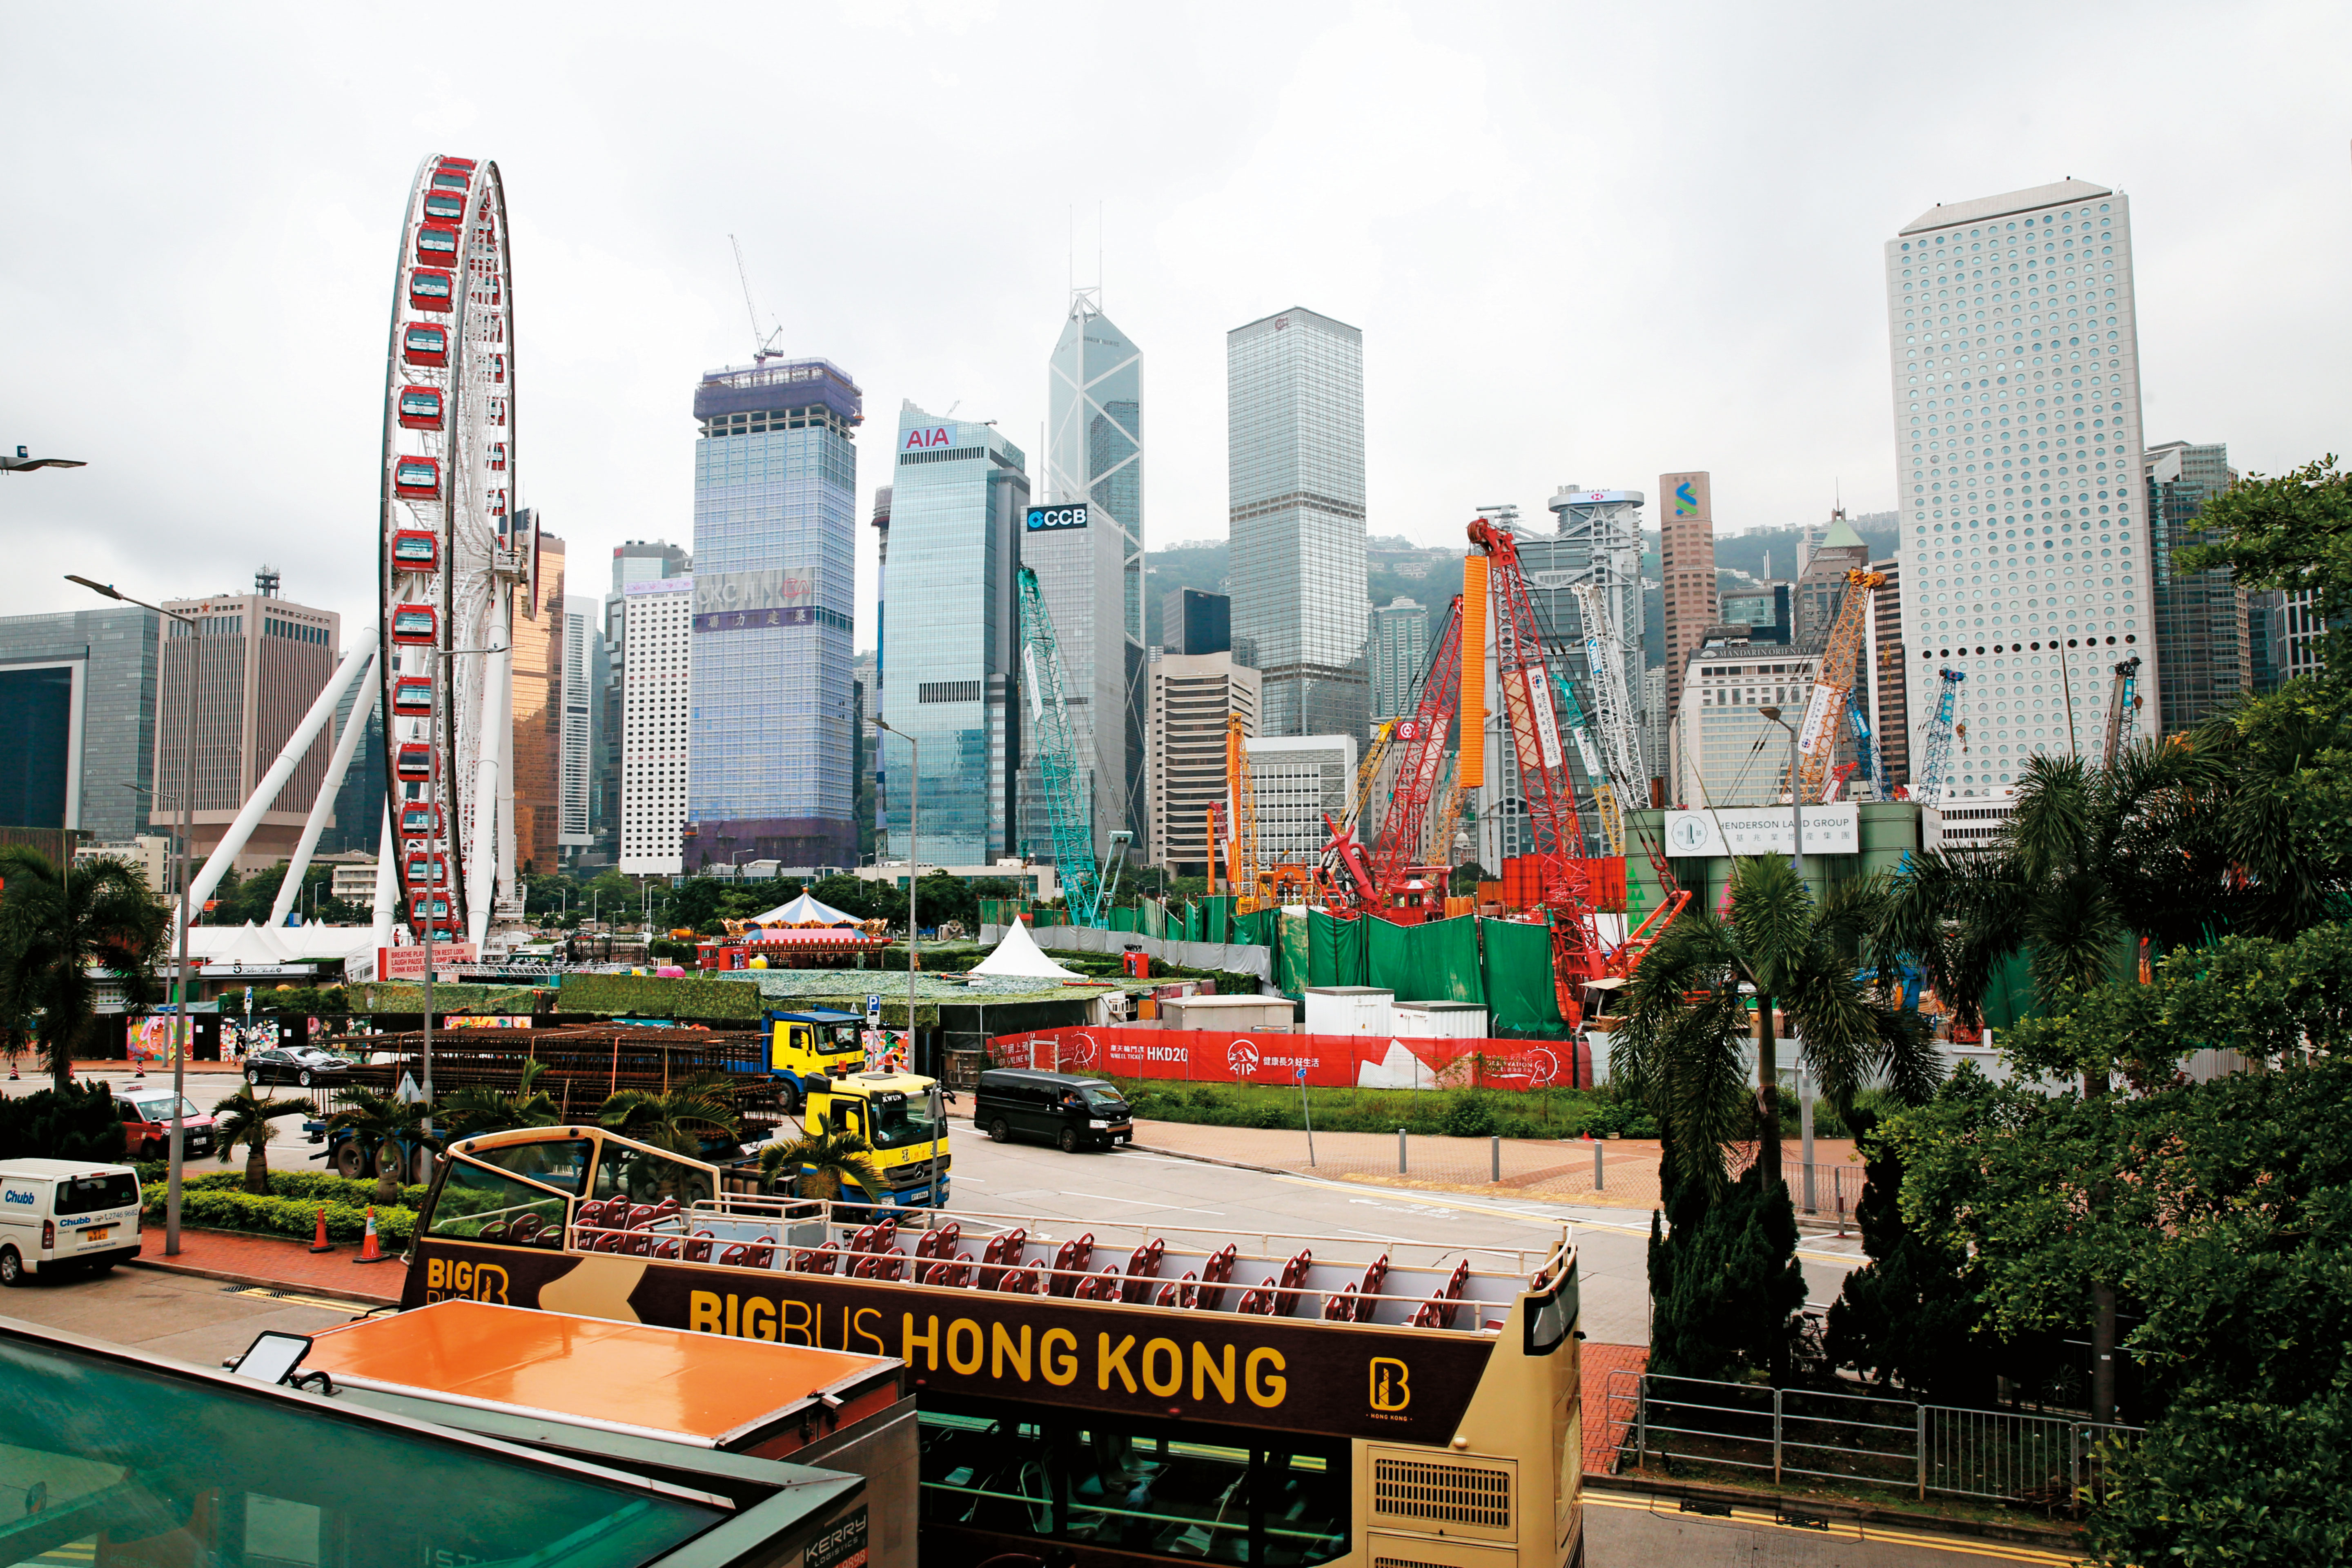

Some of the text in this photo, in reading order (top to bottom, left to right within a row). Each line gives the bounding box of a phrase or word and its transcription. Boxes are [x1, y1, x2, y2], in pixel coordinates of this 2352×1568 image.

[906, 428, 949, 448] AIA
[1044, 509, 1087, 526] CCB
[697, 582, 736, 604] CKC
[1719, 647, 1813, 658] MANDARIN ORIENTAL
[1718, 819, 1849, 830] HENDERSON LAD GROUP
[245, 987, 251, 998] P
[869, 996, 878, 1009] P
[1110, 1045, 1145, 1053] 摩天輪門票
[1147, 1046, 1188, 1062] HKD20
[1229, 1062, 1256, 1075] AIA
[1263, 1056, 1319, 1067] 健康長久好生活
[882, 1094, 902, 1102] KWUN
[5, 1190, 34, 1205] Chubb
[60, 1209, 138, 1227] Chubb 2746 9682
[428, 1258, 472, 1291] BIG
[902, 1312, 1078, 1386] HONG
[1098, 1332, 1287, 1408] KONG
[806, 1514, 866, 1562] KERRY
[815, 1536, 858, 1567] LOGISTICS
